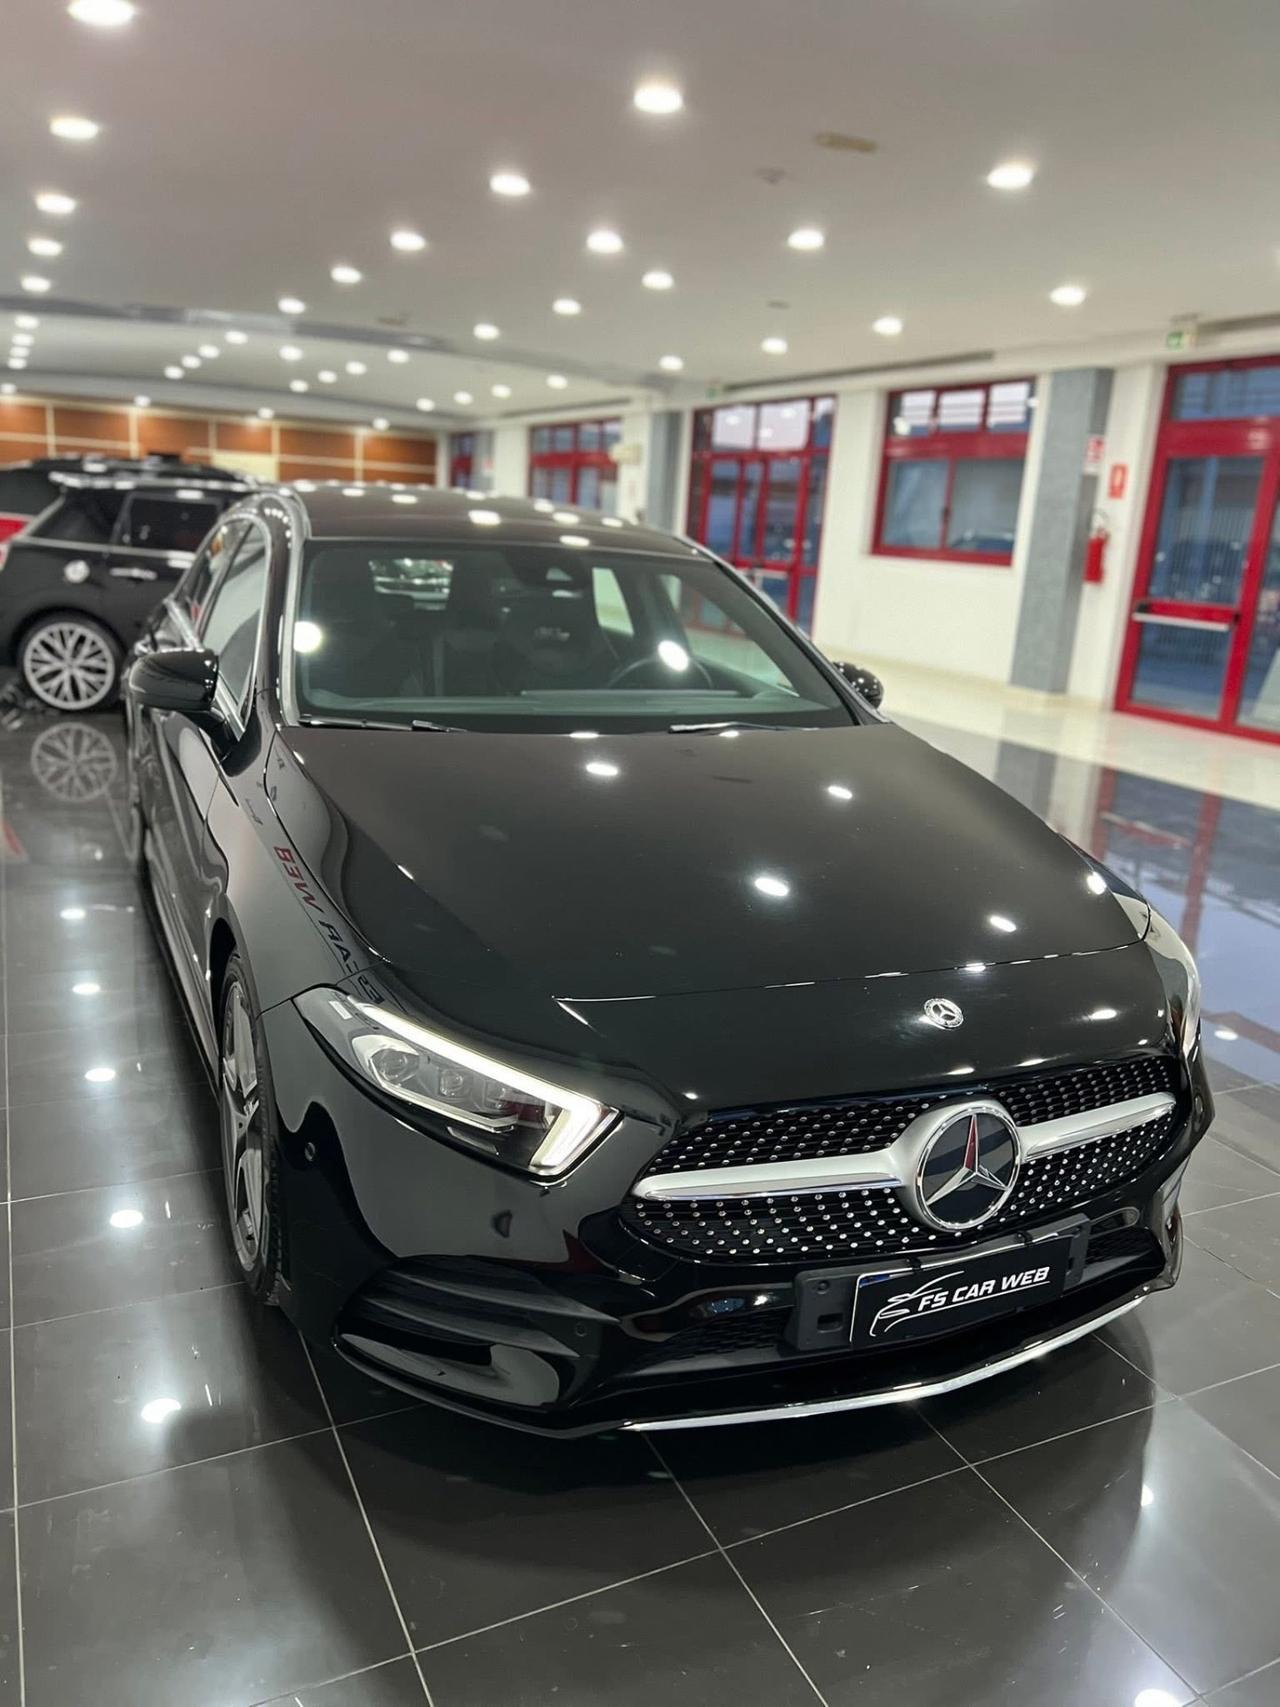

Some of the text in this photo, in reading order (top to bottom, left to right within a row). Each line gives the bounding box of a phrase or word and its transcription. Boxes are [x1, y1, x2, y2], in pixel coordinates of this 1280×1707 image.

[917, 1266, 1050, 1312] FS CAR WEB
